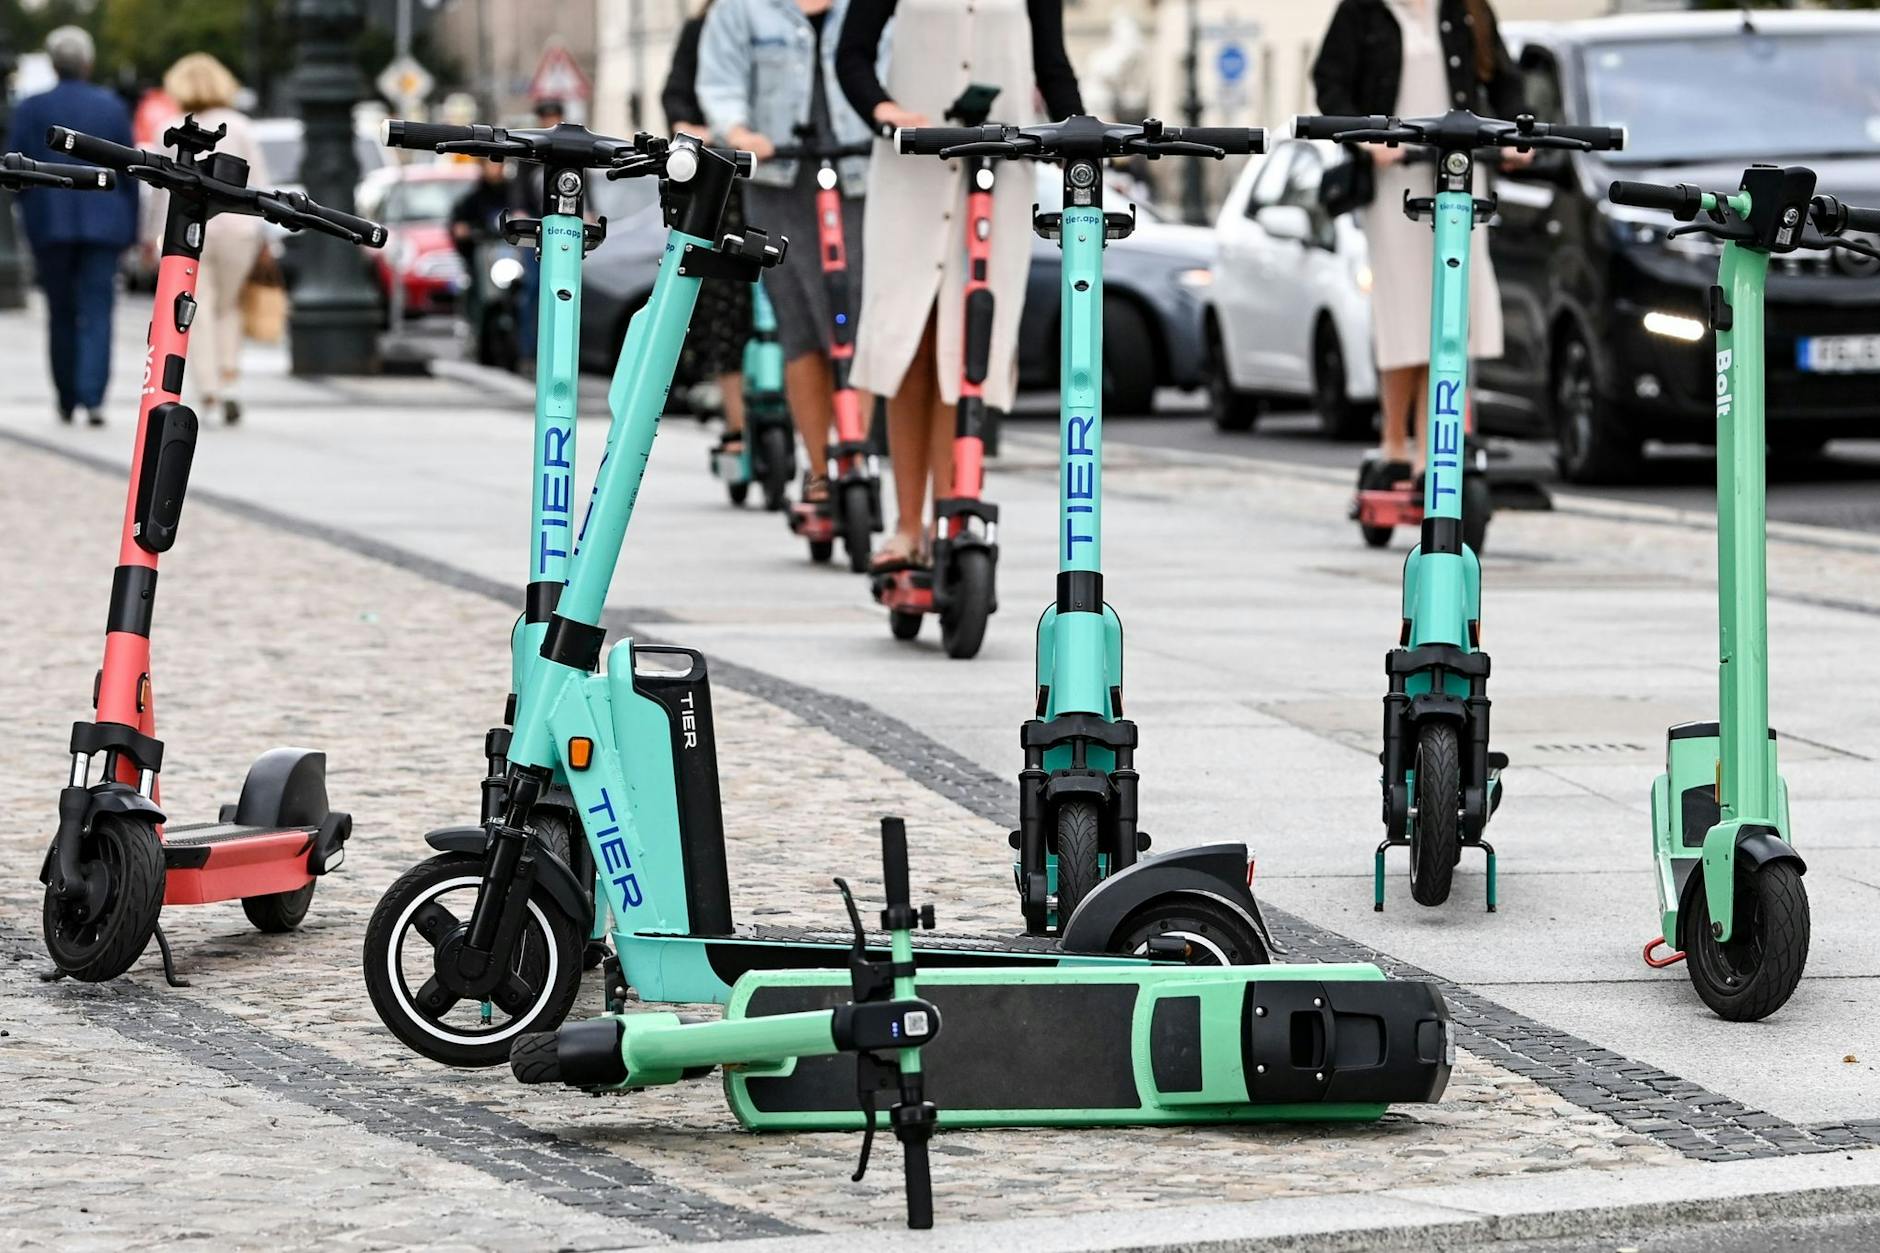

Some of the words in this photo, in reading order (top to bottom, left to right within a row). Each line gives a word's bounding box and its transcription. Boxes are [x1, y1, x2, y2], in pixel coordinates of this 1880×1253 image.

[547, 226, 581, 239] tier.app
[1065, 215, 1100, 225] tier.app
[1716, 348, 1733, 418] Bolt
[1067, 416, 1094, 561] TIER
[1432, 379, 1461, 510] TIER
[540, 427, 571, 574] TIER
[680, 691, 697, 750] TIER
[588, 787, 643, 913] TIER
